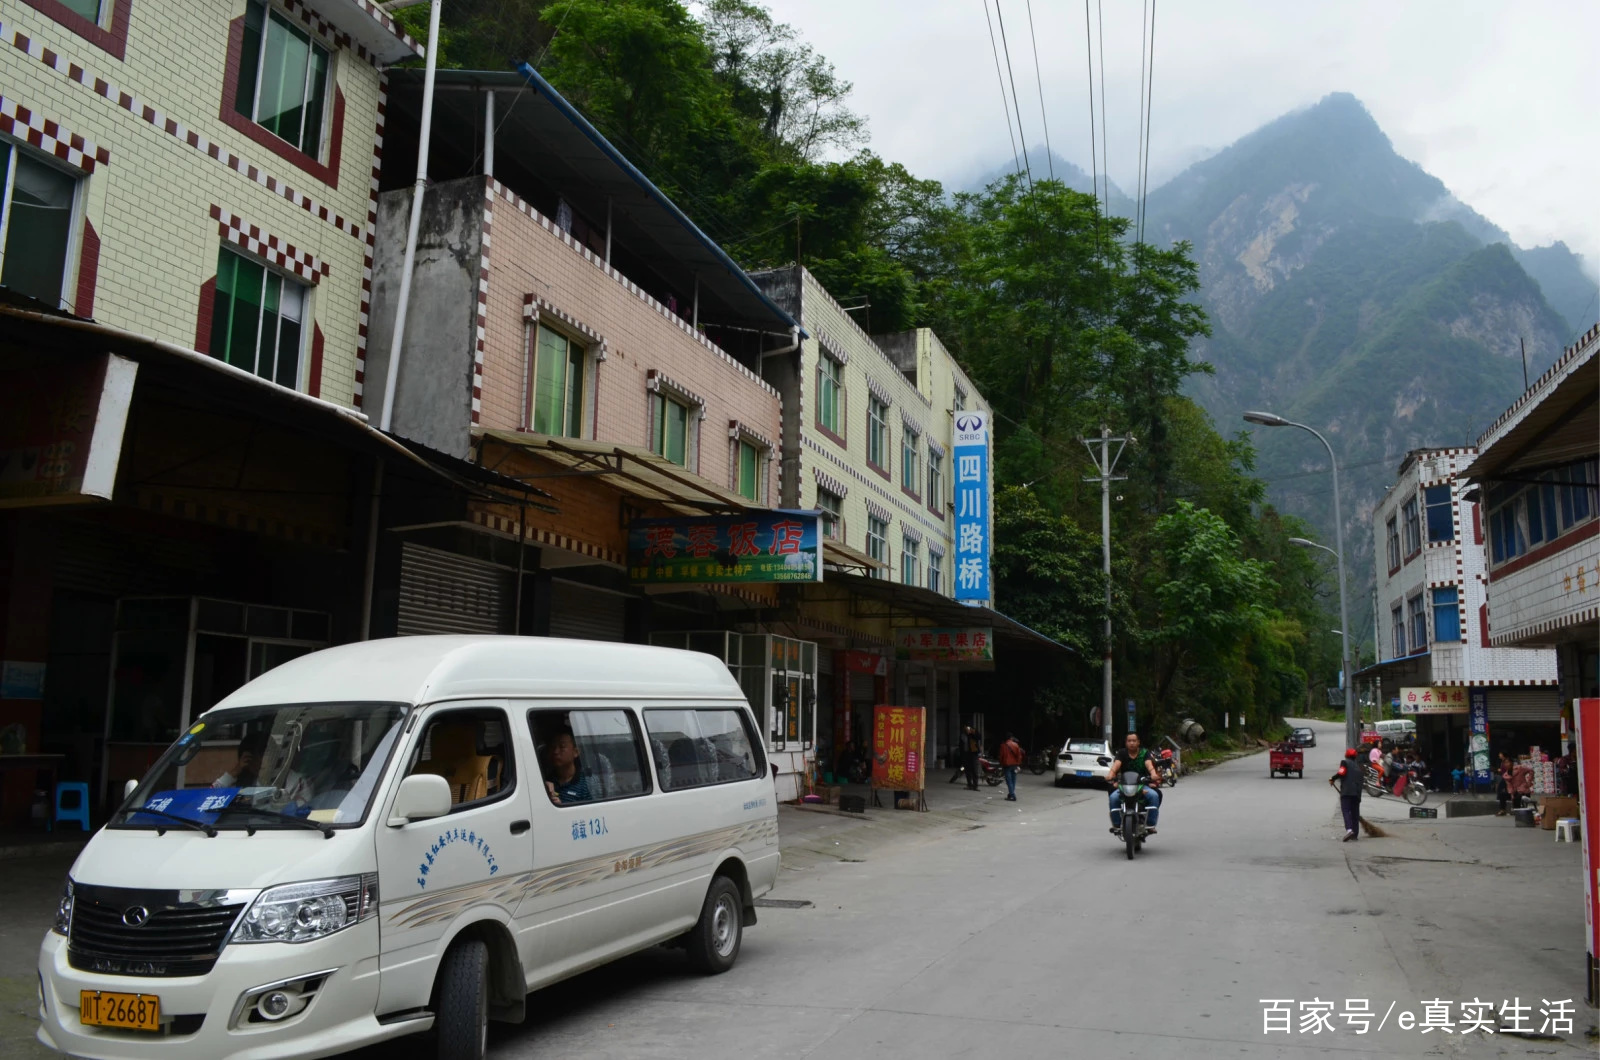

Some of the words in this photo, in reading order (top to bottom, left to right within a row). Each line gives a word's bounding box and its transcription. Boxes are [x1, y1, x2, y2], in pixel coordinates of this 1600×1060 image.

[959, 455, 983, 589] 四川路桥
[903, 632, 987, 648] 小军蔬果店
[1408, 691, 1465, 703] 白云酒楼
[887, 708, 905, 781] 云川烧烤
